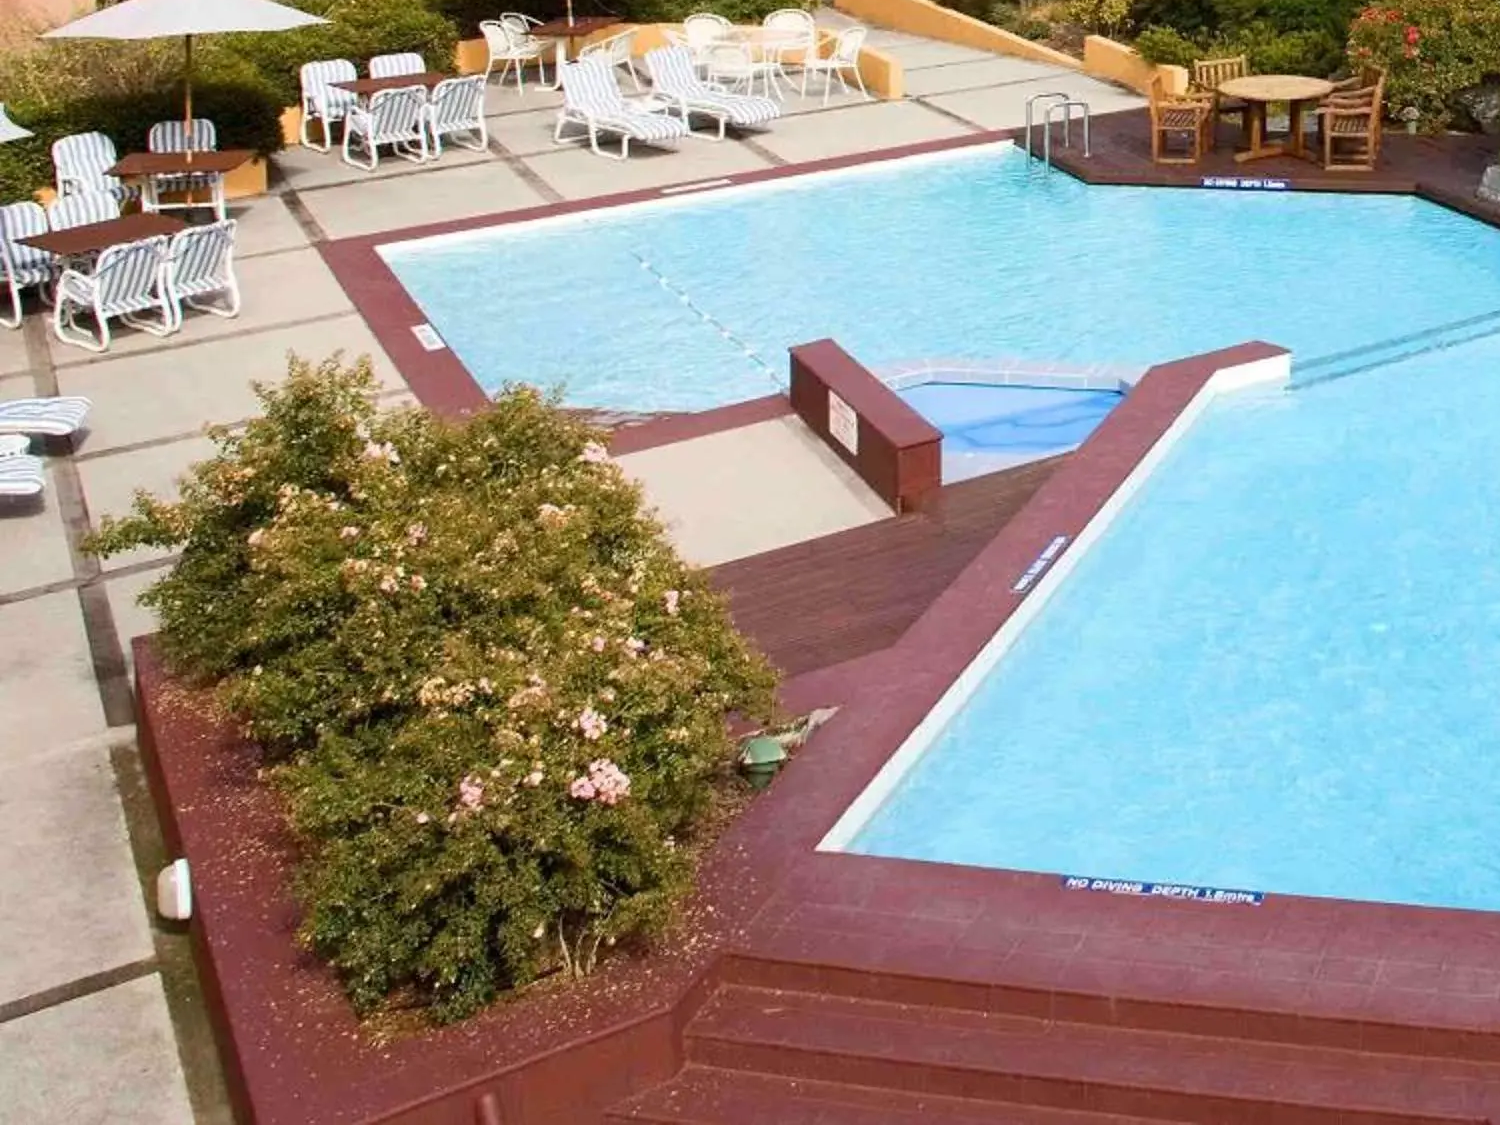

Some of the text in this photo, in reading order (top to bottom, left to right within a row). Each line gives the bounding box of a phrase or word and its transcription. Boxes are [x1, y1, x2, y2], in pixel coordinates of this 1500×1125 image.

[1066, 877, 1089, 889] NO
[1091, 880, 1143, 893] DIVING
[1151, 884, 1199, 898] DEPTH
